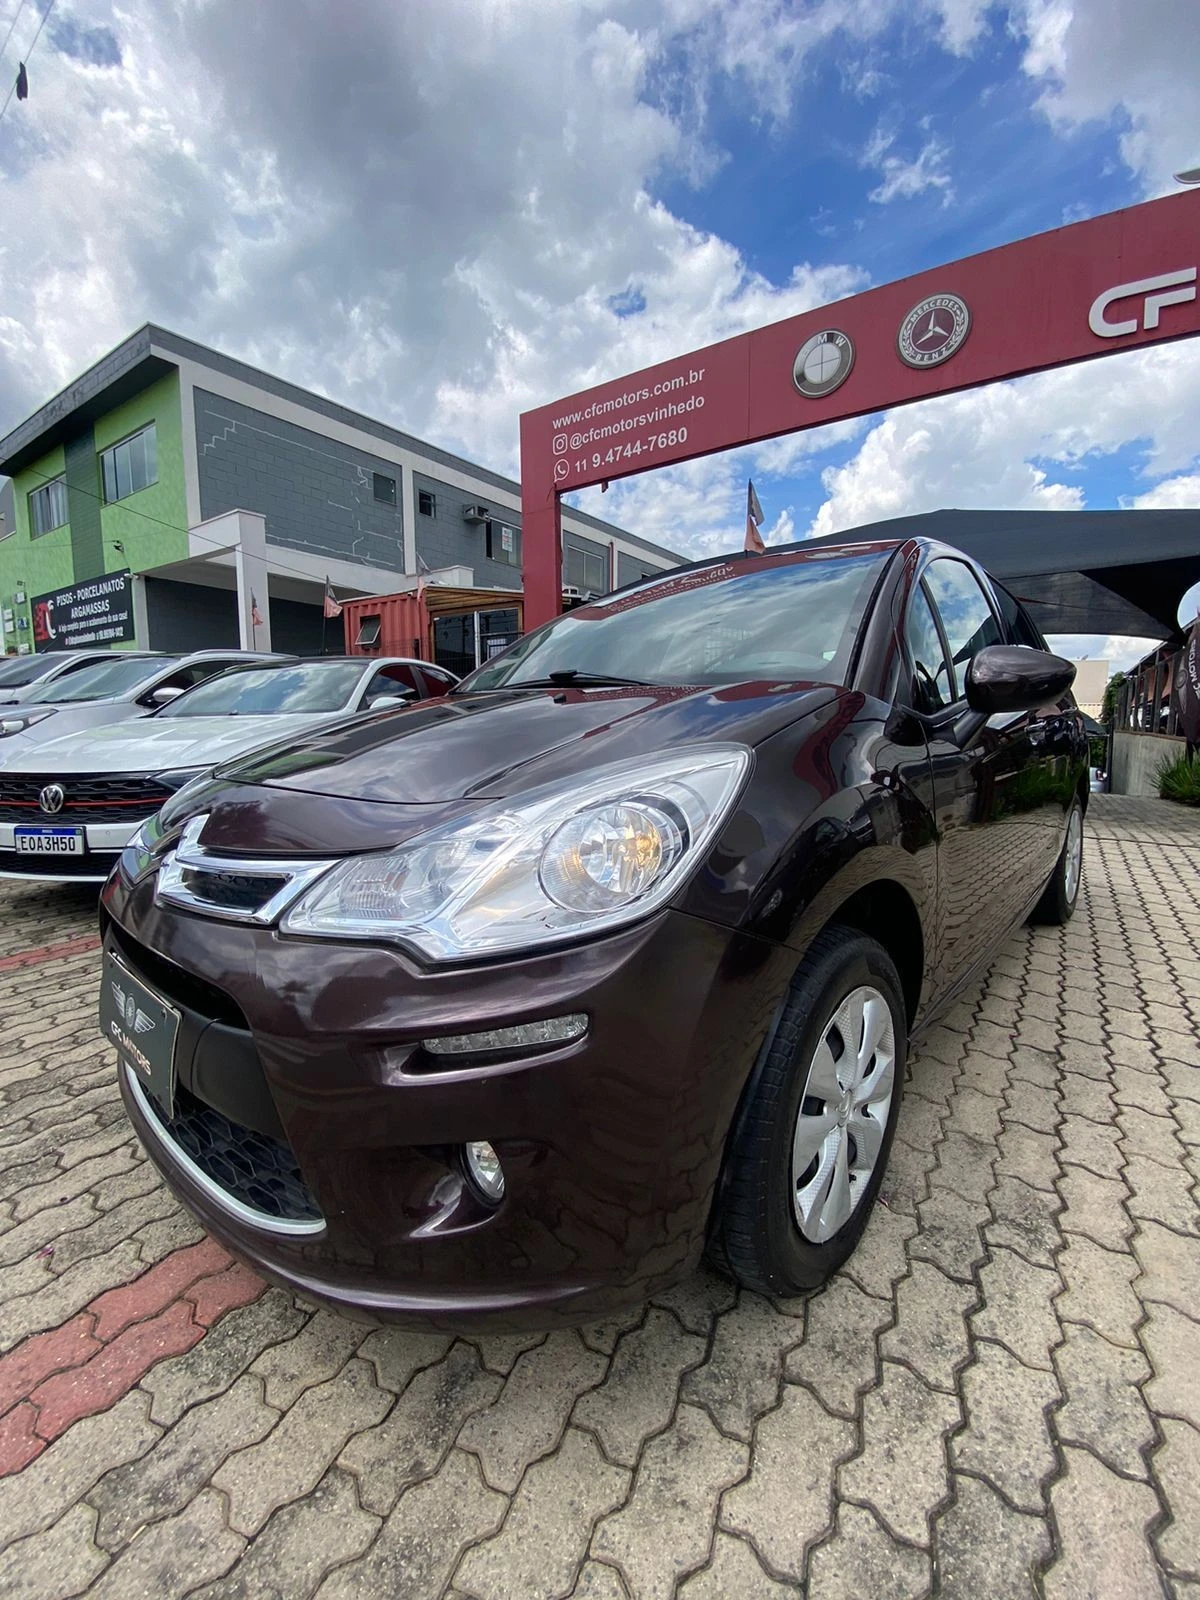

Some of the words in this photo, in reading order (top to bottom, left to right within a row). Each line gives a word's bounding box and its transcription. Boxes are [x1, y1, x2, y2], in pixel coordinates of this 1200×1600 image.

[909, 299, 959, 323] MERCEDES
[914, 347, 949, 362] BENZ
[552, 369, 705, 429] www.cfcmotors.com.br
[569, 395, 705, 450] @cfcmotorsvinhedo
[574, 459, 587, 472] 11
[592, 427, 688, 468] 9.4744-7680
[56, 592, 73, 607] PISOS
[77, 577, 125, 601] PORCELANATOS
[71, 599, 110, 619] ARGAMASSAS
[20, 836, 76, 852] EOA3H50
